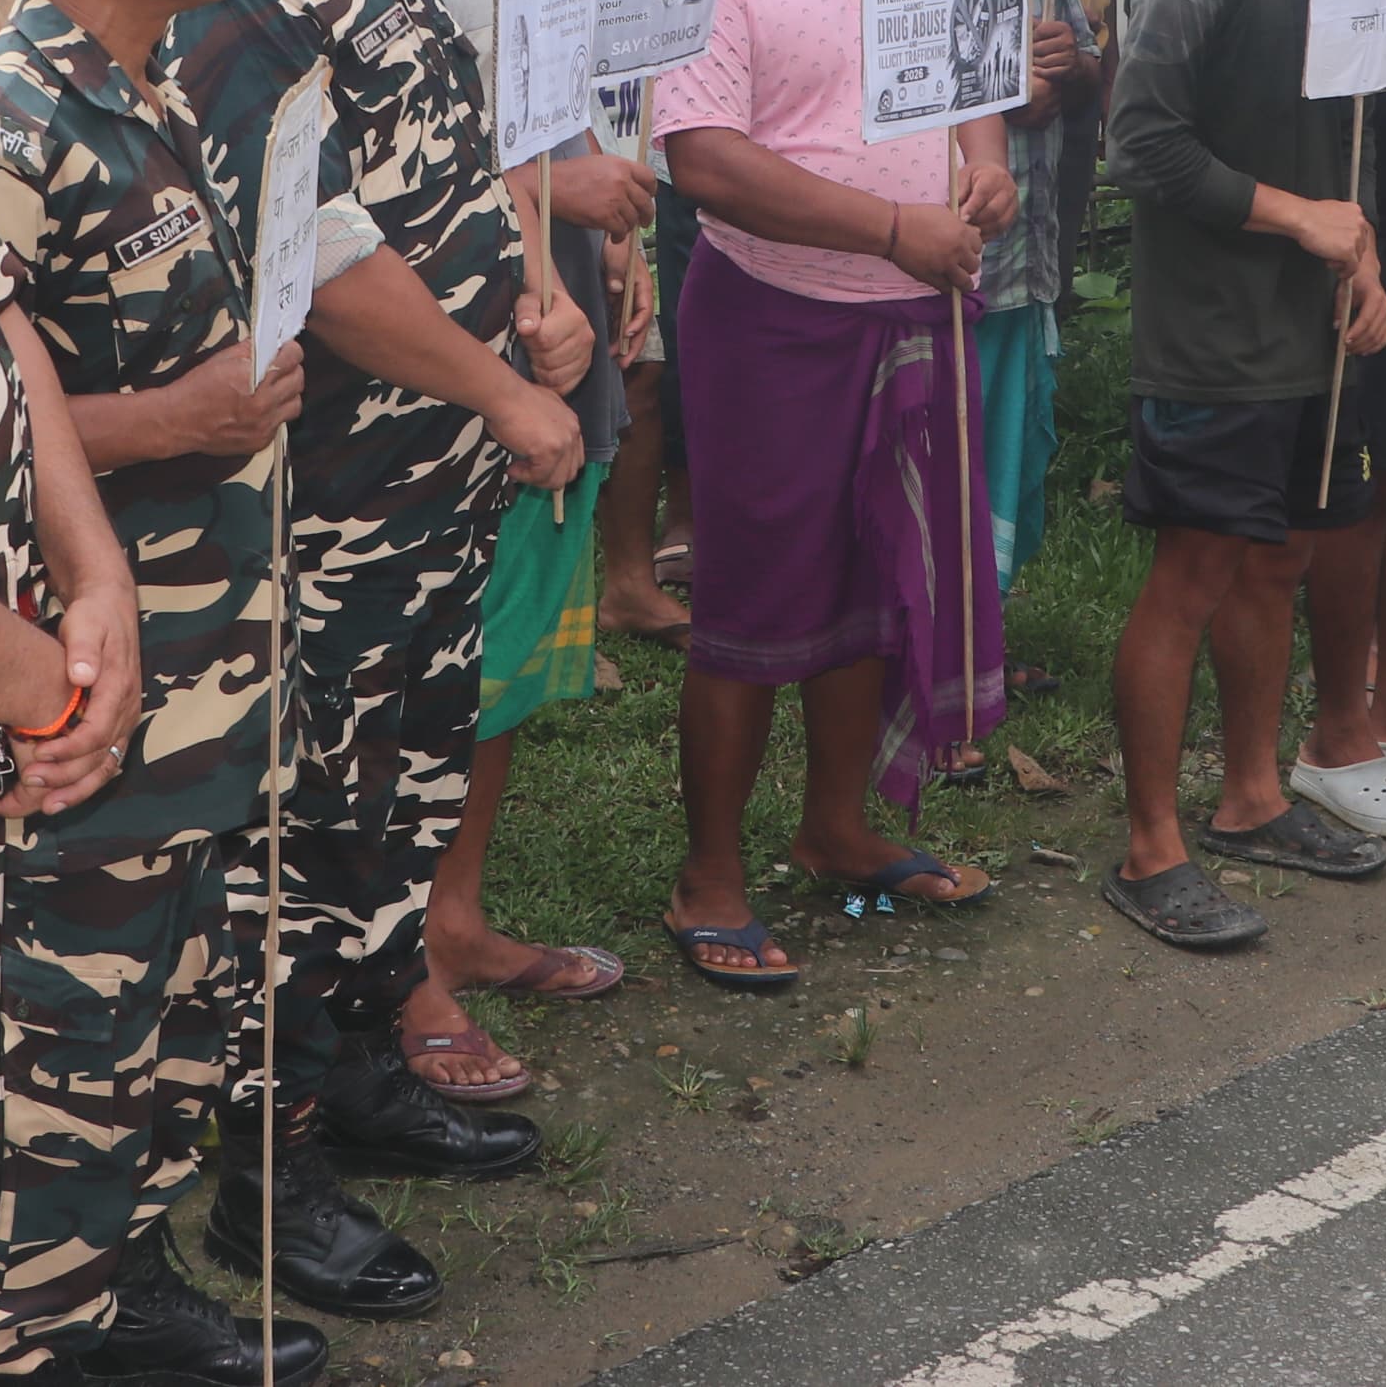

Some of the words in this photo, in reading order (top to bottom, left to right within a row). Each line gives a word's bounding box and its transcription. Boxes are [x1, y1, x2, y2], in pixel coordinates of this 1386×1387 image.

[599, 0, 622, 14] your
[661, 23, 701, 47] DRUGS
[878, 14, 908, 45] DRUG
[912, 8, 947, 39] ABUSE
[611, 36, 642, 56] SAY
[878, 50, 903, 70] ILLICIT
[905, 44, 947, 65] TRAFFICKING
[903, 68, 924, 80] 2026
[130, 241, 143, 258] P
[151, 215, 191, 248] SUMPA
